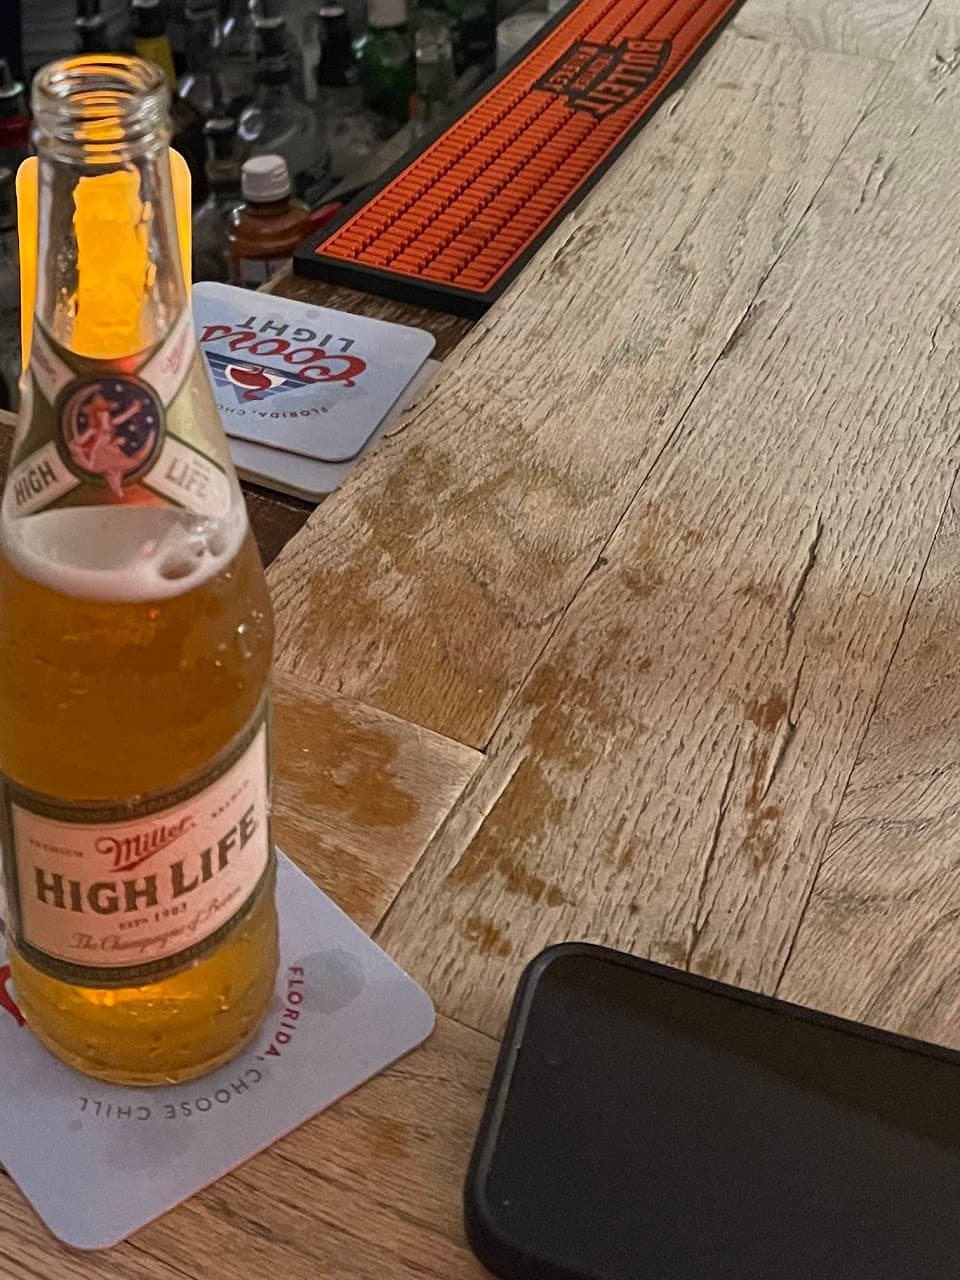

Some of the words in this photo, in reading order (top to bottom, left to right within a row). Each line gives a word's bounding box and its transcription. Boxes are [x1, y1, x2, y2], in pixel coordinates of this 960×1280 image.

[575, 40, 664, 114] BULLEIT
[200, 325, 367, 388] Coors
[236, 316, 356, 353] LIGHT
[14, 460, 59, 507] HIGH
[165, 458, 210, 498] LIFE
[34, 865, 158, 916] HIGH
[169, 804, 259, 900] LIFE
[95, 815, 198, 873] Miller
[68, 932, 100, 950] The
[100, 926, 187, 953] Champagne
[78, 1096, 151, 1121] CHILL
[164, 1068, 263, 1120] CHOOSE
